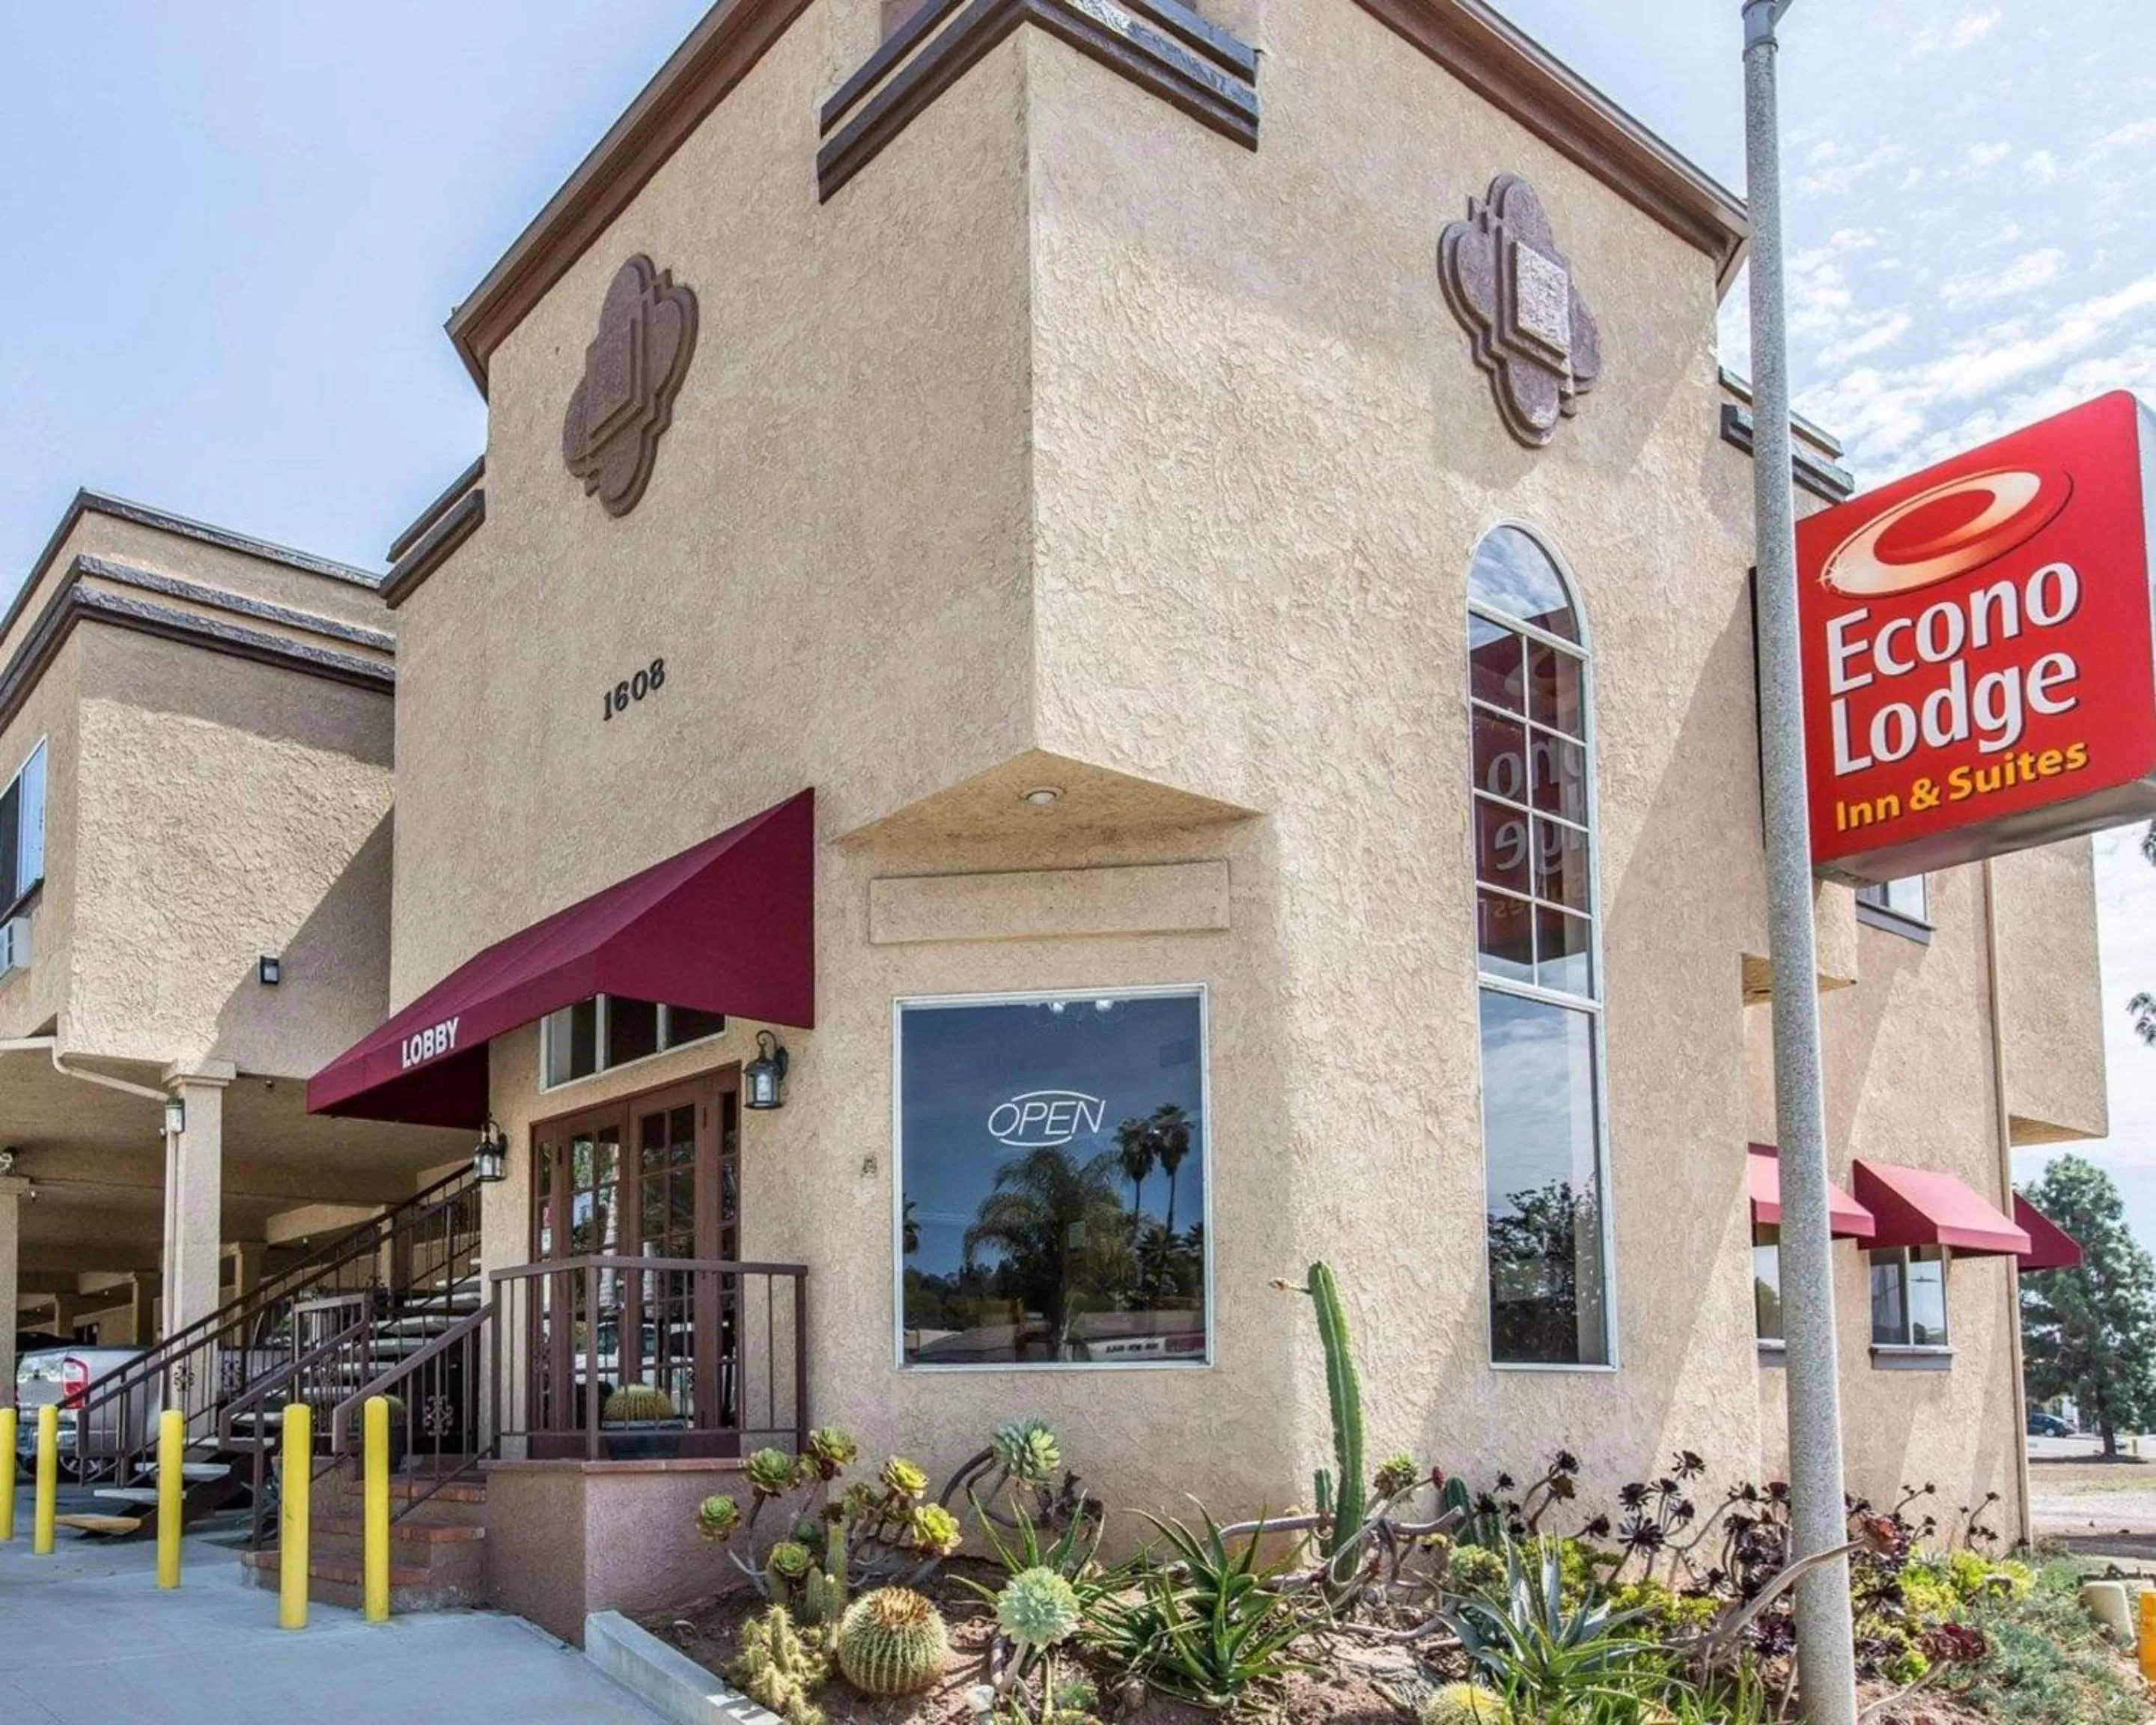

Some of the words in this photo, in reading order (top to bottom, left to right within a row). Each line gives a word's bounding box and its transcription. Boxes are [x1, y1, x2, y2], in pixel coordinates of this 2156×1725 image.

[1826, 562, 2079, 696] Econo
[603, 657, 665, 721] 1608
[1830, 652, 2078, 776] Lodge
[1836, 793, 1900, 831] Inn
[1910, 777, 1941, 812] &
[1948, 742, 2089, 800] Suites
[402, 1016, 459, 1070] LOBBY
[988, 1100, 1106, 1137] OPEN
